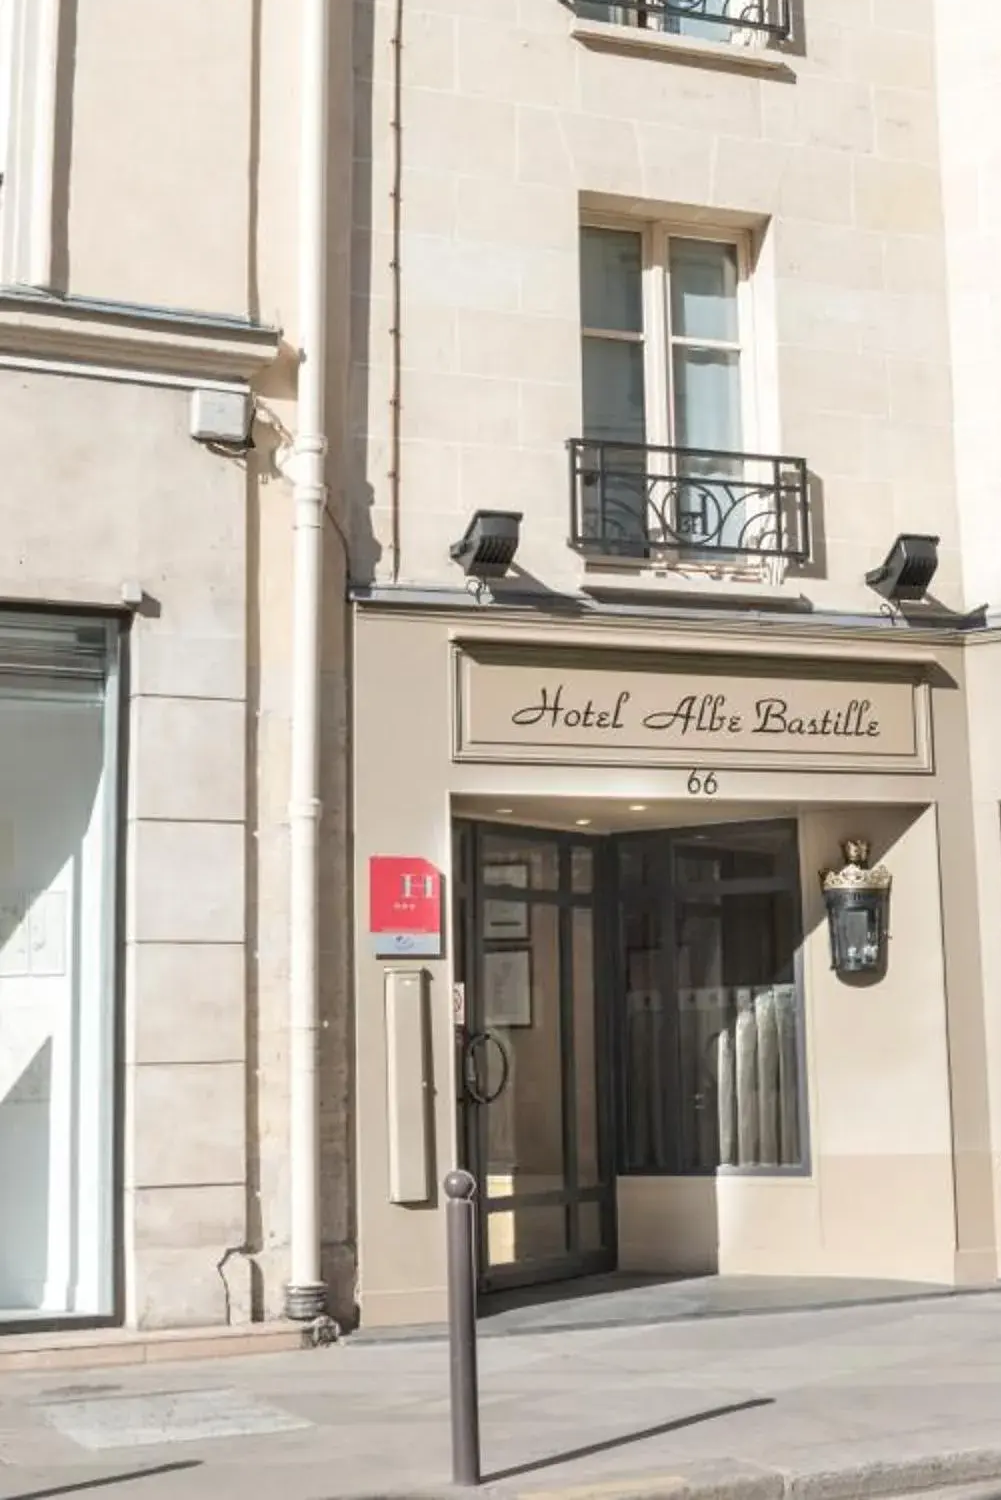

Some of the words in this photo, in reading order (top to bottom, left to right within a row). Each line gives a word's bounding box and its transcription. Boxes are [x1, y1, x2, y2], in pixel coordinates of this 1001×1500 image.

[511, 684, 630, 730] Hotel
[642, 694, 743, 736] Albe
[752, 698, 881, 738] Bastille
[686, 767, 718, 795] 66
[400, 874, 440, 899] H
